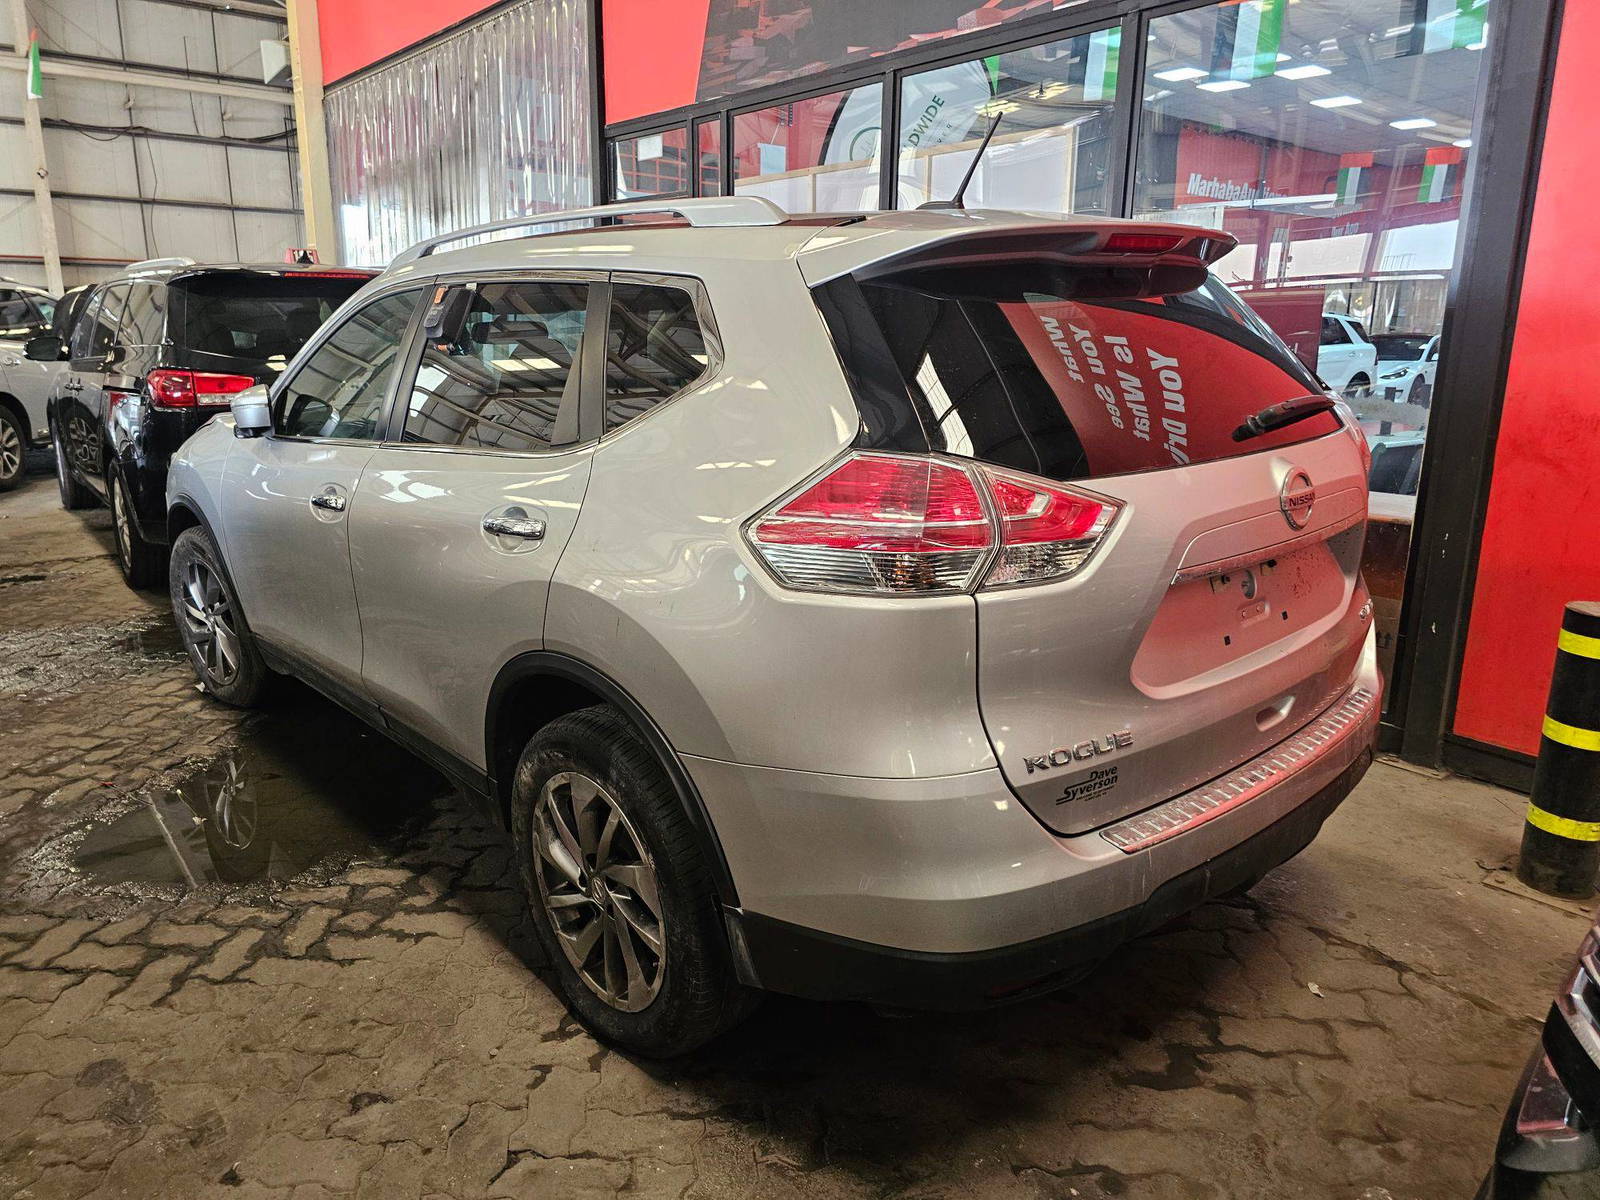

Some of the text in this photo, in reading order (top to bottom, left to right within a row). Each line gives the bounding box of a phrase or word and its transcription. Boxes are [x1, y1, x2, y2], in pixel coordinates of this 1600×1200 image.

[1023, 729, 1135, 774] ROGUE
[1089, 766, 1118, 780] Dave
[1060, 775, 1118, 802] Syverson
